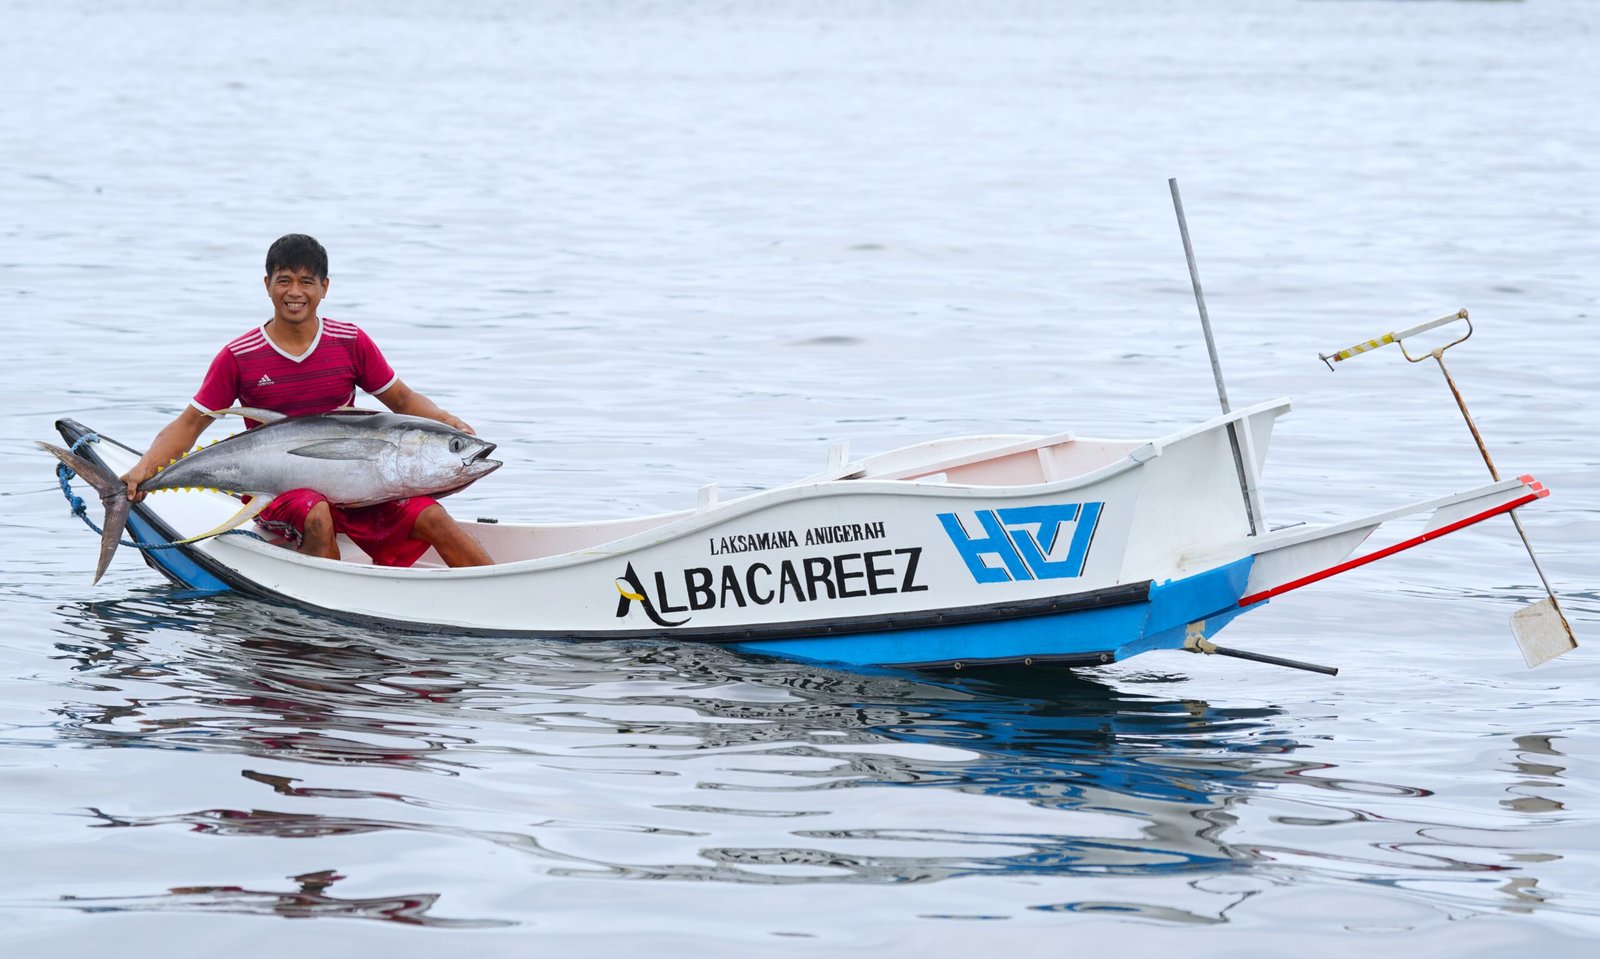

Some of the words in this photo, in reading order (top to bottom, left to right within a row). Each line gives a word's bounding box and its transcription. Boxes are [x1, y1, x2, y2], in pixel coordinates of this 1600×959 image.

[709, 530, 798, 556] LAKSAMANA
[804, 521, 886, 546] ANUGERAH
[614, 547, 929, 627] ALBACAREEZ
